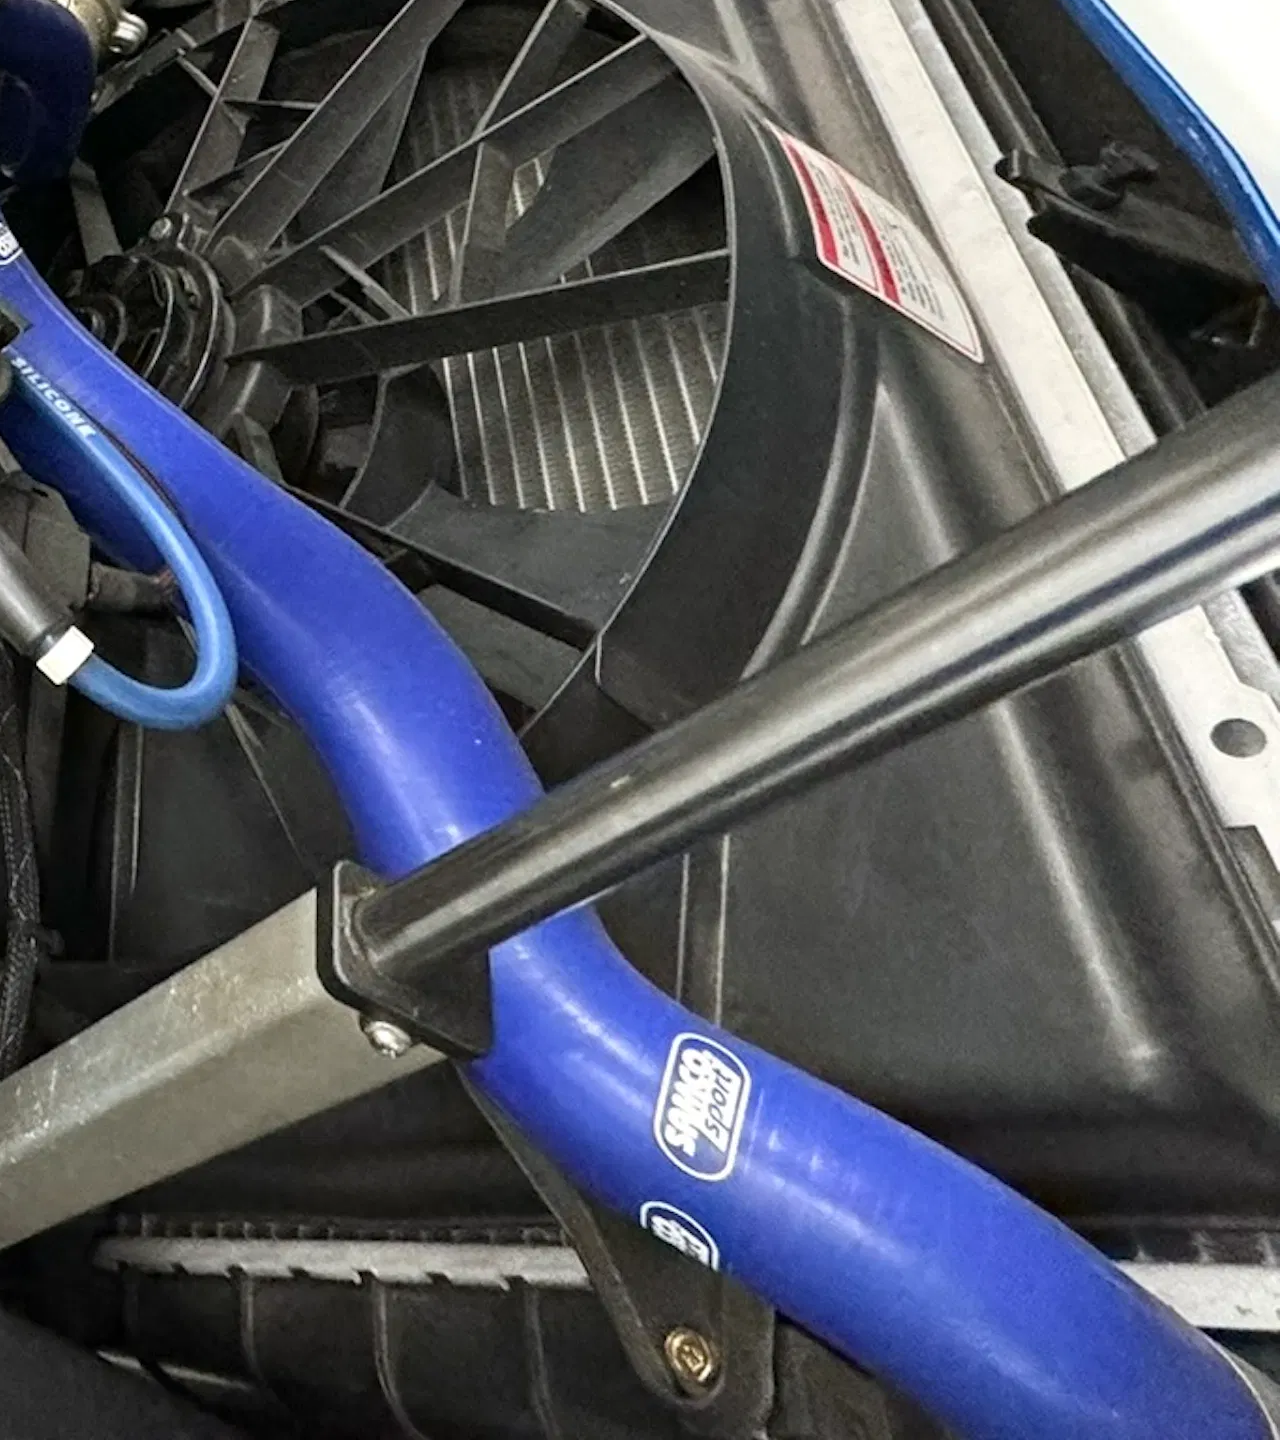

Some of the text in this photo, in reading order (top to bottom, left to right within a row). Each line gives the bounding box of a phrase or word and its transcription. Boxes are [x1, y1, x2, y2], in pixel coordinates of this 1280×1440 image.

[10, 356, 97, 439] SILICONE
[663, 1047, 708, 1158] SAMCO
[703, 1068, 733, 1140] sport
